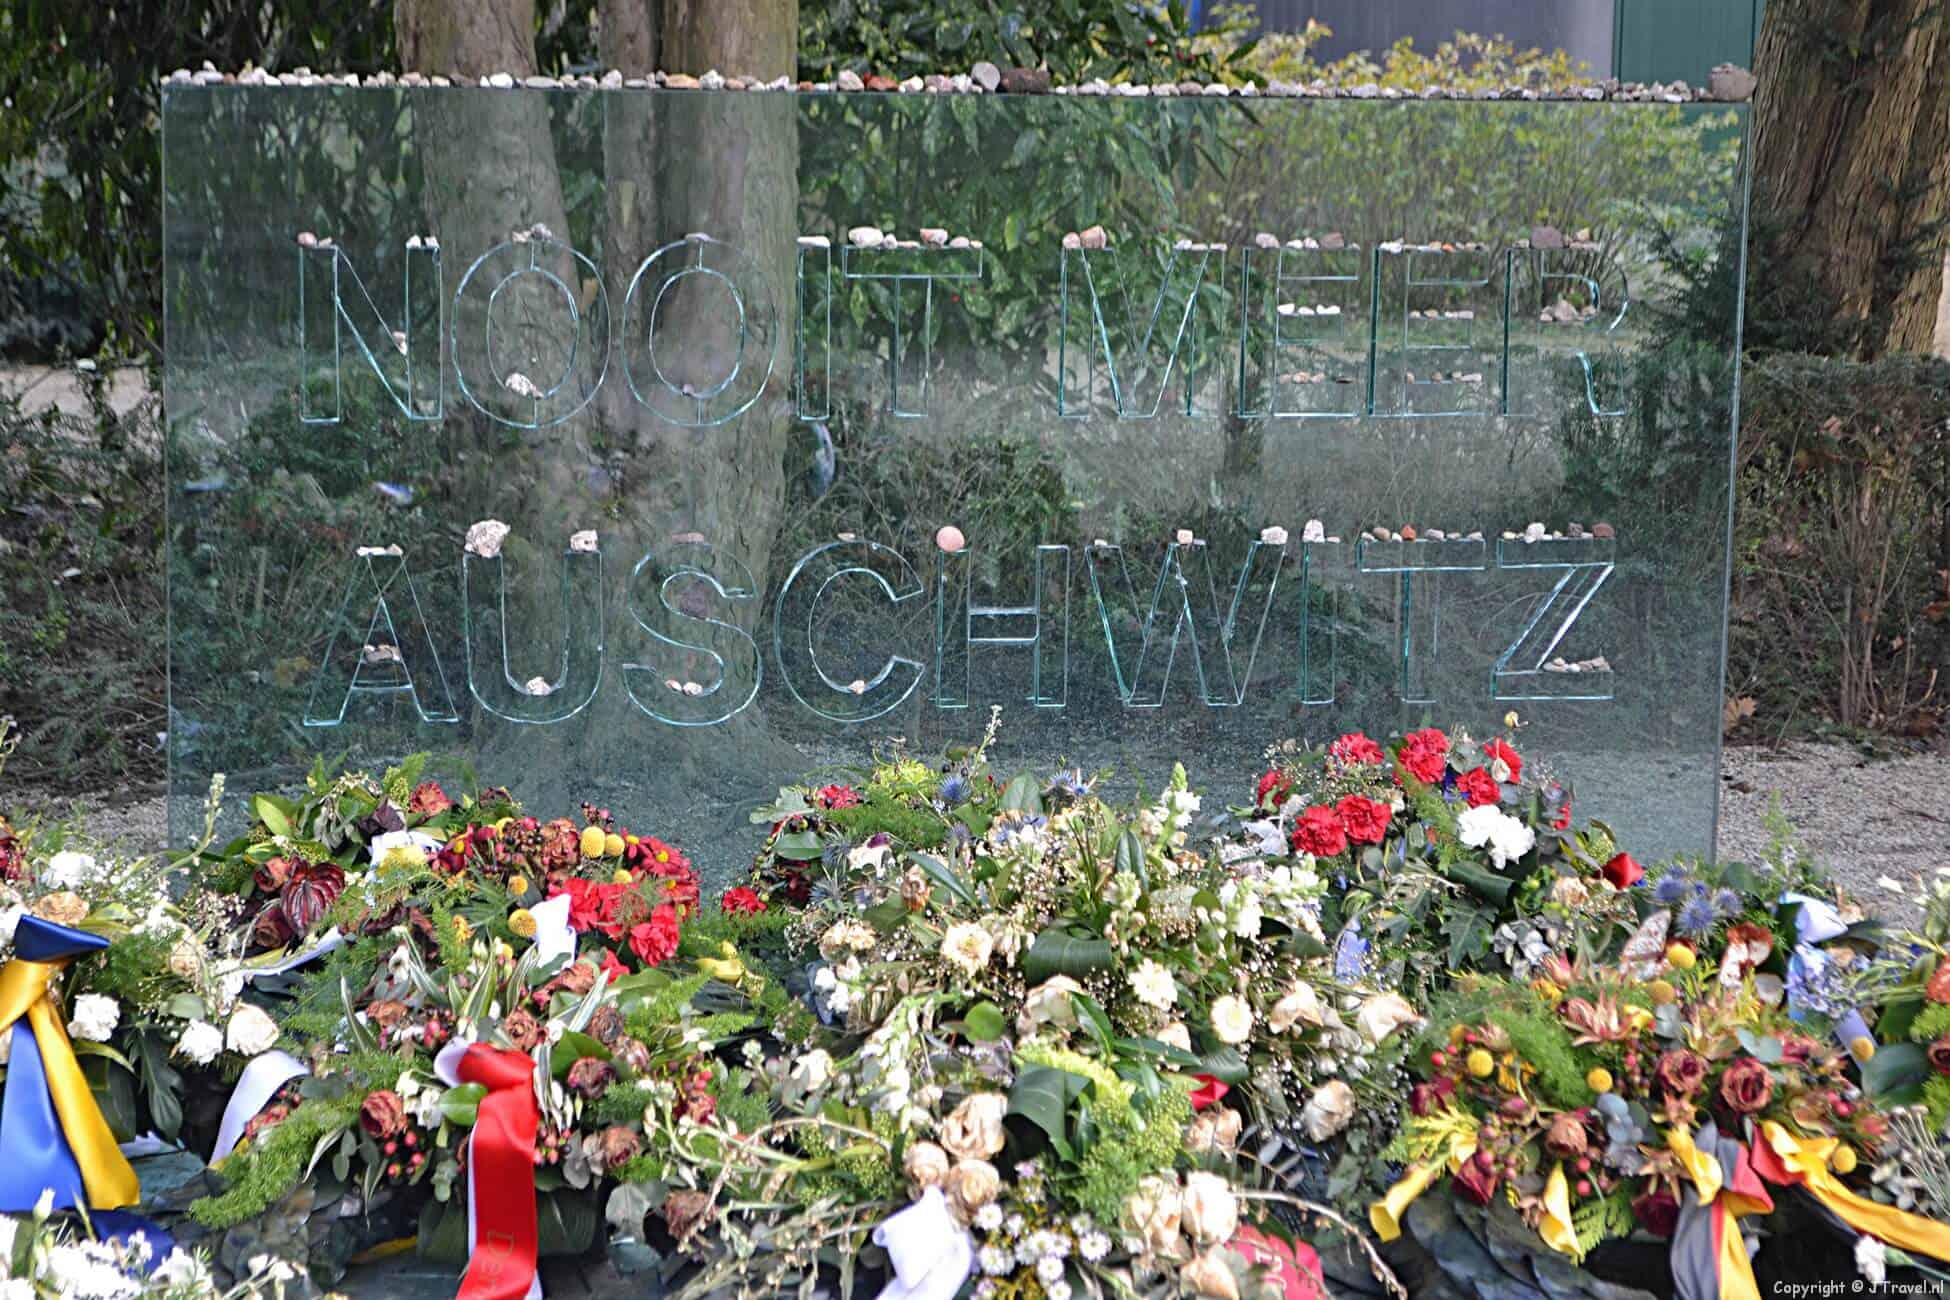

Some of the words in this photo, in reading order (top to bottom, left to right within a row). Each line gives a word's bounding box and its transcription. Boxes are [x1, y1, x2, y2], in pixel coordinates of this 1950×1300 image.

[298, 235, 985, 429] NOOIT
[1057, 241, 1630, 420] MEER
[302, 534, 1618, 728] AUSCHWITZ
